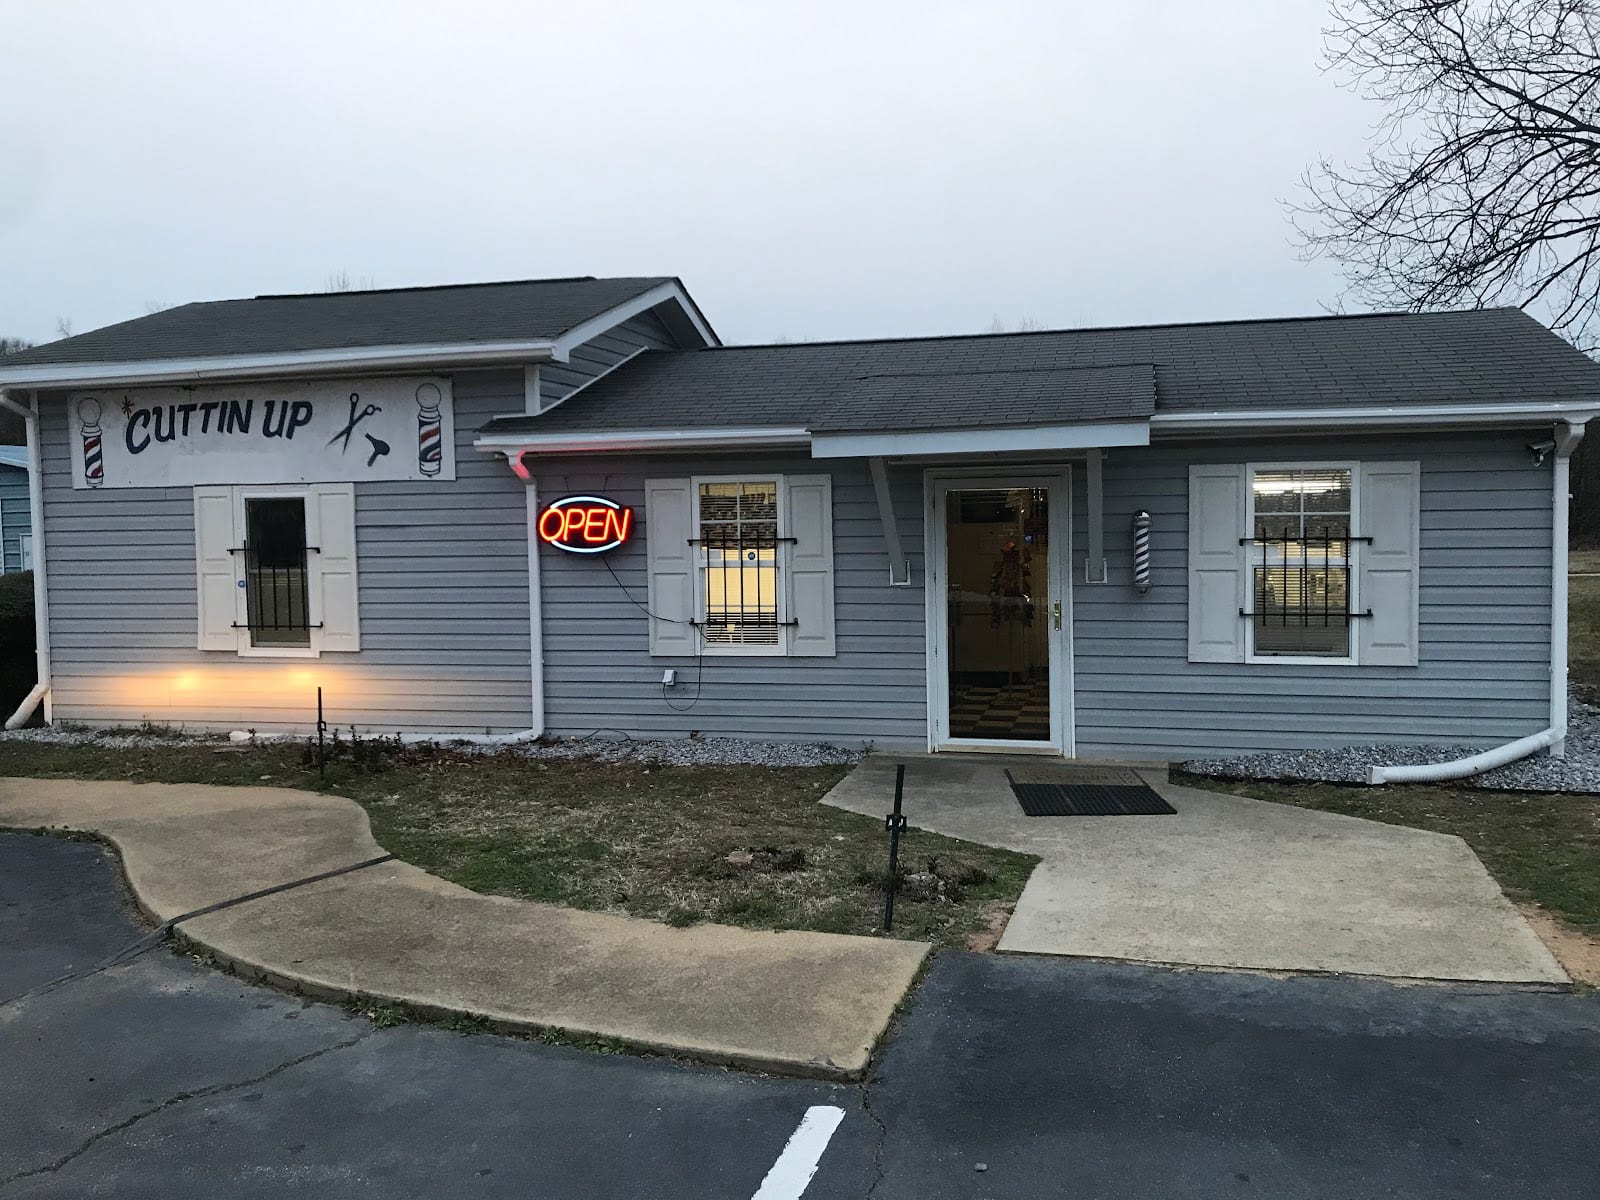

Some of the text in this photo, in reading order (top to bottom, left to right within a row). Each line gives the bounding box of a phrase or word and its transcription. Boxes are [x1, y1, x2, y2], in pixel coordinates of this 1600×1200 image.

[125, 400, 313, 454] CUTTIN UP
[539, 508, 630, 541] OPEN
